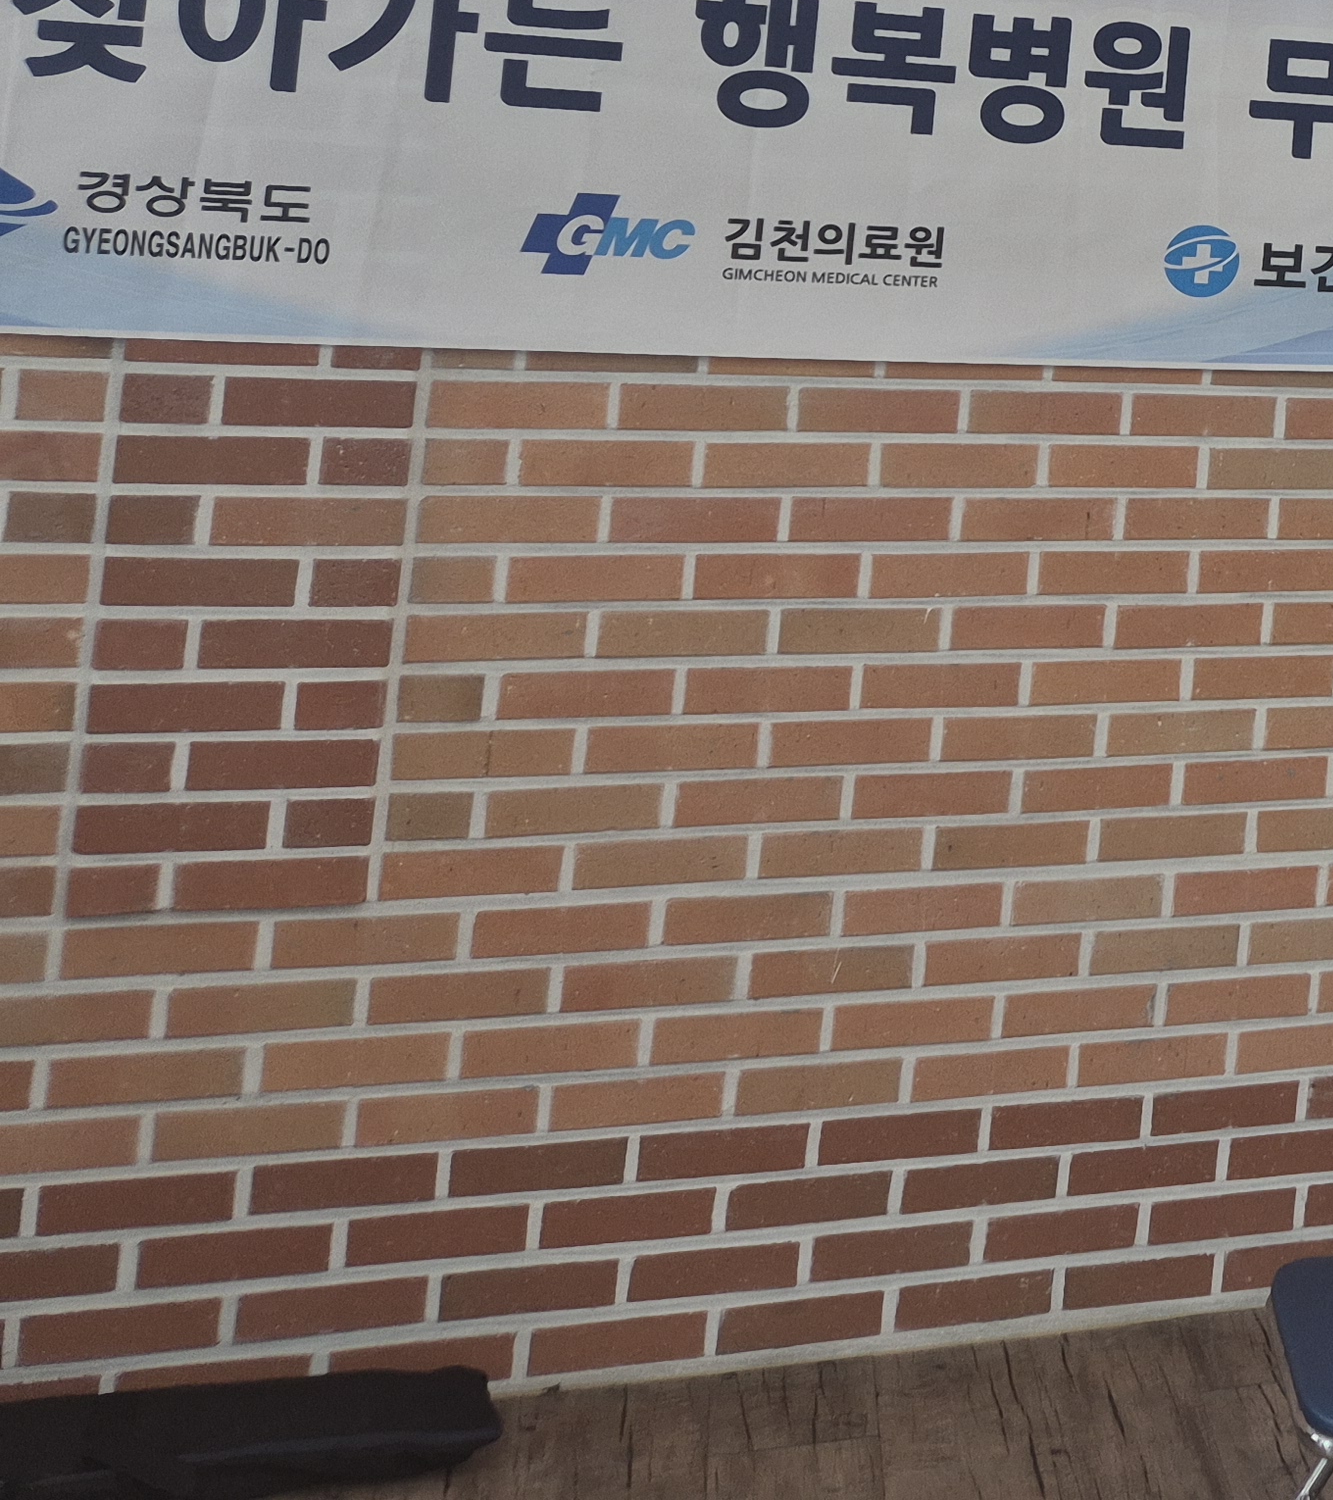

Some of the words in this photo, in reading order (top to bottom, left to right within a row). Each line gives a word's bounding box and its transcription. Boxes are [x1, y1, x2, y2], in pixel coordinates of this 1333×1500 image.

[77, 171, 311, 223] 경상북도
[63, 226, 330, 264] GYEONGSANGBUK-DO
[556, 214, 696, 260] GMC
[724, 217, 945, 268] 김천의료원
[722, 267, 807, 284] GIMCHEON
[812, 271, 879, 287] MEDICAL
[882, 273, 938, 288] CENTER
